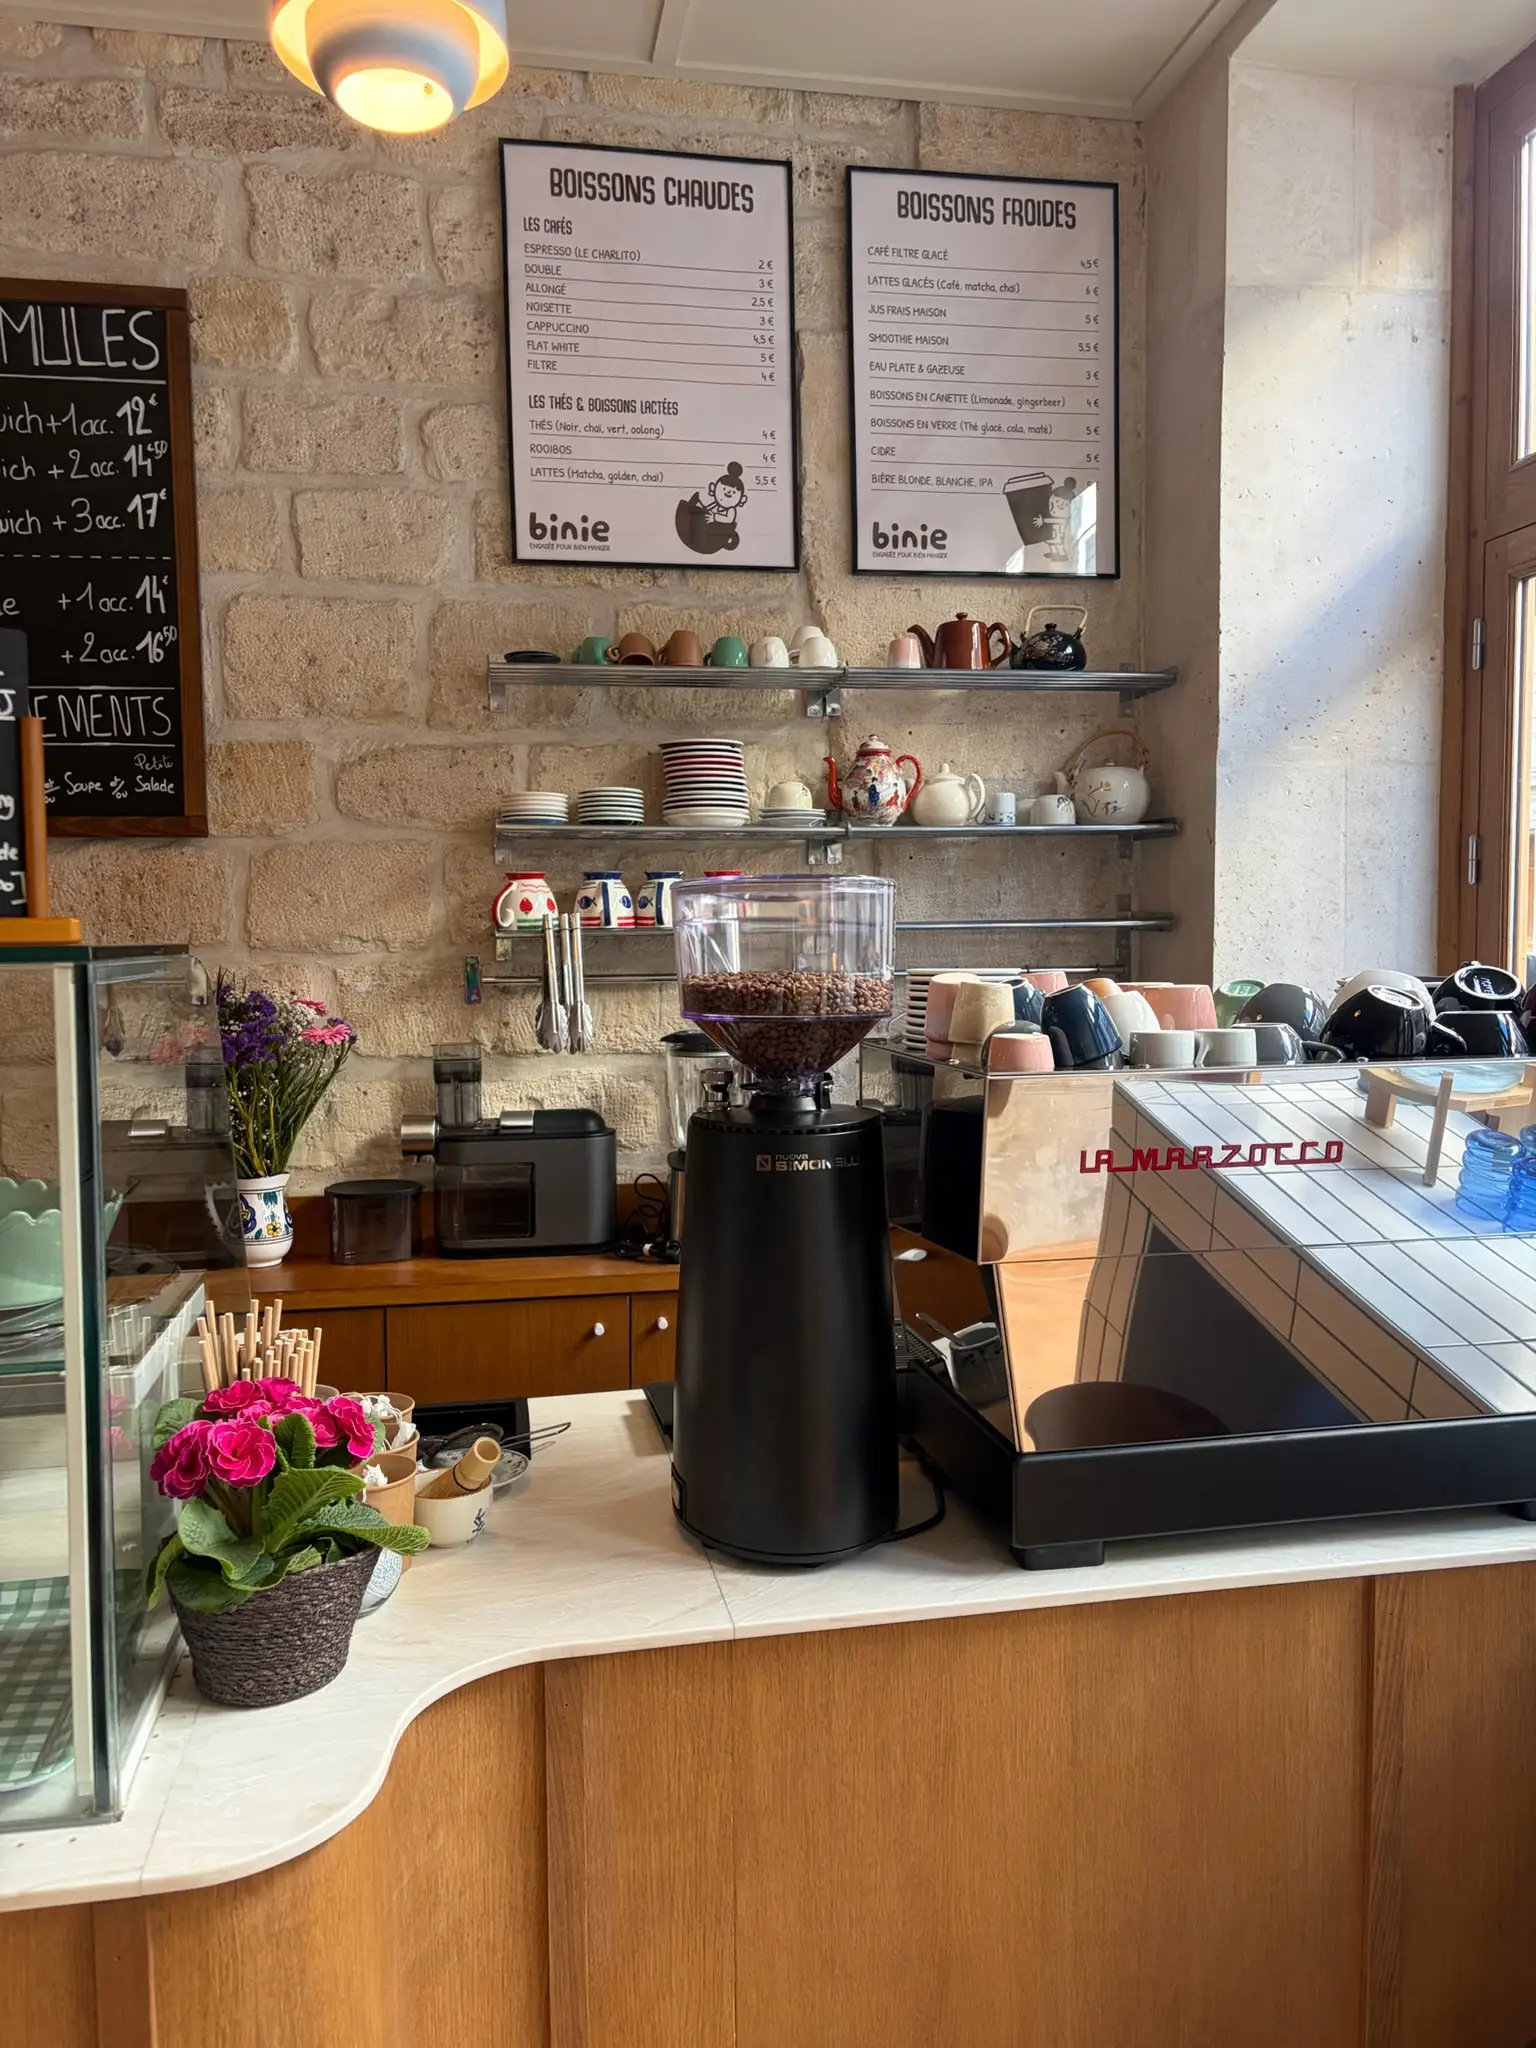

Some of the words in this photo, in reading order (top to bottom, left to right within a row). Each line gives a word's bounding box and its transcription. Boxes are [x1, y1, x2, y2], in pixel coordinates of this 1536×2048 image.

[550, 168, 655, 204] BOISSONS
[664, 177, 754, 213] CHAUDES
[897, 190, 994, 225] BOISSONS
[1002, 197, 1076, 229] FROIDES
[523, 217, 540, 232] LES
[544, 216, 573, 235] CAFÉS
[524, 243, 572, 256] ESPRESSO
[575, 246, 589, 258] (LE
[591, 249, 641, 261] CHARLITO)
[759, 260, 764, 270] 2
[767, 260, 774, 270] €
[867, 245, 889, 256] CAFÉ
[891, 247, 919, 259] FILTRE
[922, 249, 948, 260] GLACÉ
[1080, 260, 1092, 269] 4,5
[1093, 258, 1099, 268] €
[524, 263, 562, 276] DOUBLE
[759, 279, 765, 288] 3
[767, 279, 774, 289] €
[868, 276, 900, 287] LATTES
[902, 276, 934, 289] GLACÉS
[937, 280, 963, 291] (Café,
[965, 282, 997, 293] matcha,
[1086, 286, 1091, 295] 6
[1093, 287, 1099, 296] €
[525, 282, 566, 295] ALLONGÉ
[752, 297, 766, 307] 2,5
[768, 298, 774, 307] €
[526, 302, 572, 314] NOISETTE
[760, 316, 766, 326] 3
[768, 317, 774, 326] €
[868, 304, 885, 315] JUS
[887, 305, 911, 316] FRAIS
[913, 307, 947, 317] MAISON
[1085, 315, 1091, 324] 5
[1093, 315, 1099, 324] €
[526, 320, 590, 334] CAPPUCCINO
[753, 334, 766, 345] 4,5
[768, 335, 774, 345] €
[868, 333, 913, 344] SMOOTHIE
[915, 335, 949, 346] MAISON
[1078, 343, 1091, 352] 5,5
[1093, 343, 1099, 352] €
[527, 340, 549, 351] FLAT
[551, 342, 580, 352] WHITE
[760, 353, 766, 362] 5
[768, 354, 775, 363] €
[527, 360, 557, 370] FILTRE
[761, 372, 766, 381] 4
[769, 372, 775, 381] €
[869, 361, 887, 372] EAU
[889, 362, 915, 373] PLATE
[918, 364, 924, 373] &
[927, 364, 966, 375] GAZEUSE
[1086, 371, 1091, 380] 3
[1093, 371, 1099, 380] €
[528, 394, 545, 409] LES
[549, 393, 573, 410] THÉS
[576, 397, 584, 412] &
[588, 398, 636, 413] BOISSONS
[640, 398, 678, 416] LACTÉES
[870, 390, 914, 401] BOISSONS
[916, 391, 928, 401] EN
[930, 392, 968, 404] CANETTE
[971, 393, 1014, 406] (Limonade,
[1017, 396, 1066, 409] gingerbeer)
[1086, 398, 1091, 407] 4
[1094, 398, 1099, 408] €
[529, 418, 553, 430] THÉS
[555, 420, 581, 433] (Noir,
[607, 425, 628, 435] vert,
[631, 424, 664, 438] oolong)
[763, 430, 767, 439] 4
[770, 430, 776, 439] €
[870, 418, 914, 429] BOISSONS
[917, 420, 929, 430] EN
[931, 420, 957, 430] VERRE
[960, 421, 979, 432] (Thé
[981, 422, 1005, 435] glacé,
[1006, 424, 1025, 434] cola,
[1028, 424, 1052, 435] maté)
[1086, 426, 1091, 435] 5
[1094, 426, 1099, 435] €
[530, 444, 572, 455] ROOIBOS
[763, 453, 768, 462] 4
[770, 454, 776, 462] €
[871, 446, 896, 456] CIDRE
[1086, 454, 1092, 463] 5
[1094, 454, 1100, 463] €
[530, 467, 564, 478] LATTES
[567, 467, 605, 480] (Matcha,
[608, 471, 639, 484] golden,
[755, 476, 768, 486] 5,5
[771, 476, 776, 485] €
[872, 472, 896, 484] BIÈRE
[898, 475, 934, 487] BLONDE,
[936, 476, 976, 487] BLANCHE,
[979, 477, 993, 487] IPA
[529, 512, 610, 542] binie
[873, 522, 947, 550] binie
[27, 695, 171, 737] EMENTS
[64, 771, 103, 796] Soupe
[135, 775, 175, 794] Salade
[1080, 1150, 1113, 1173] LA
[1132, 1141, 1344, 1171] MARZOCCO
